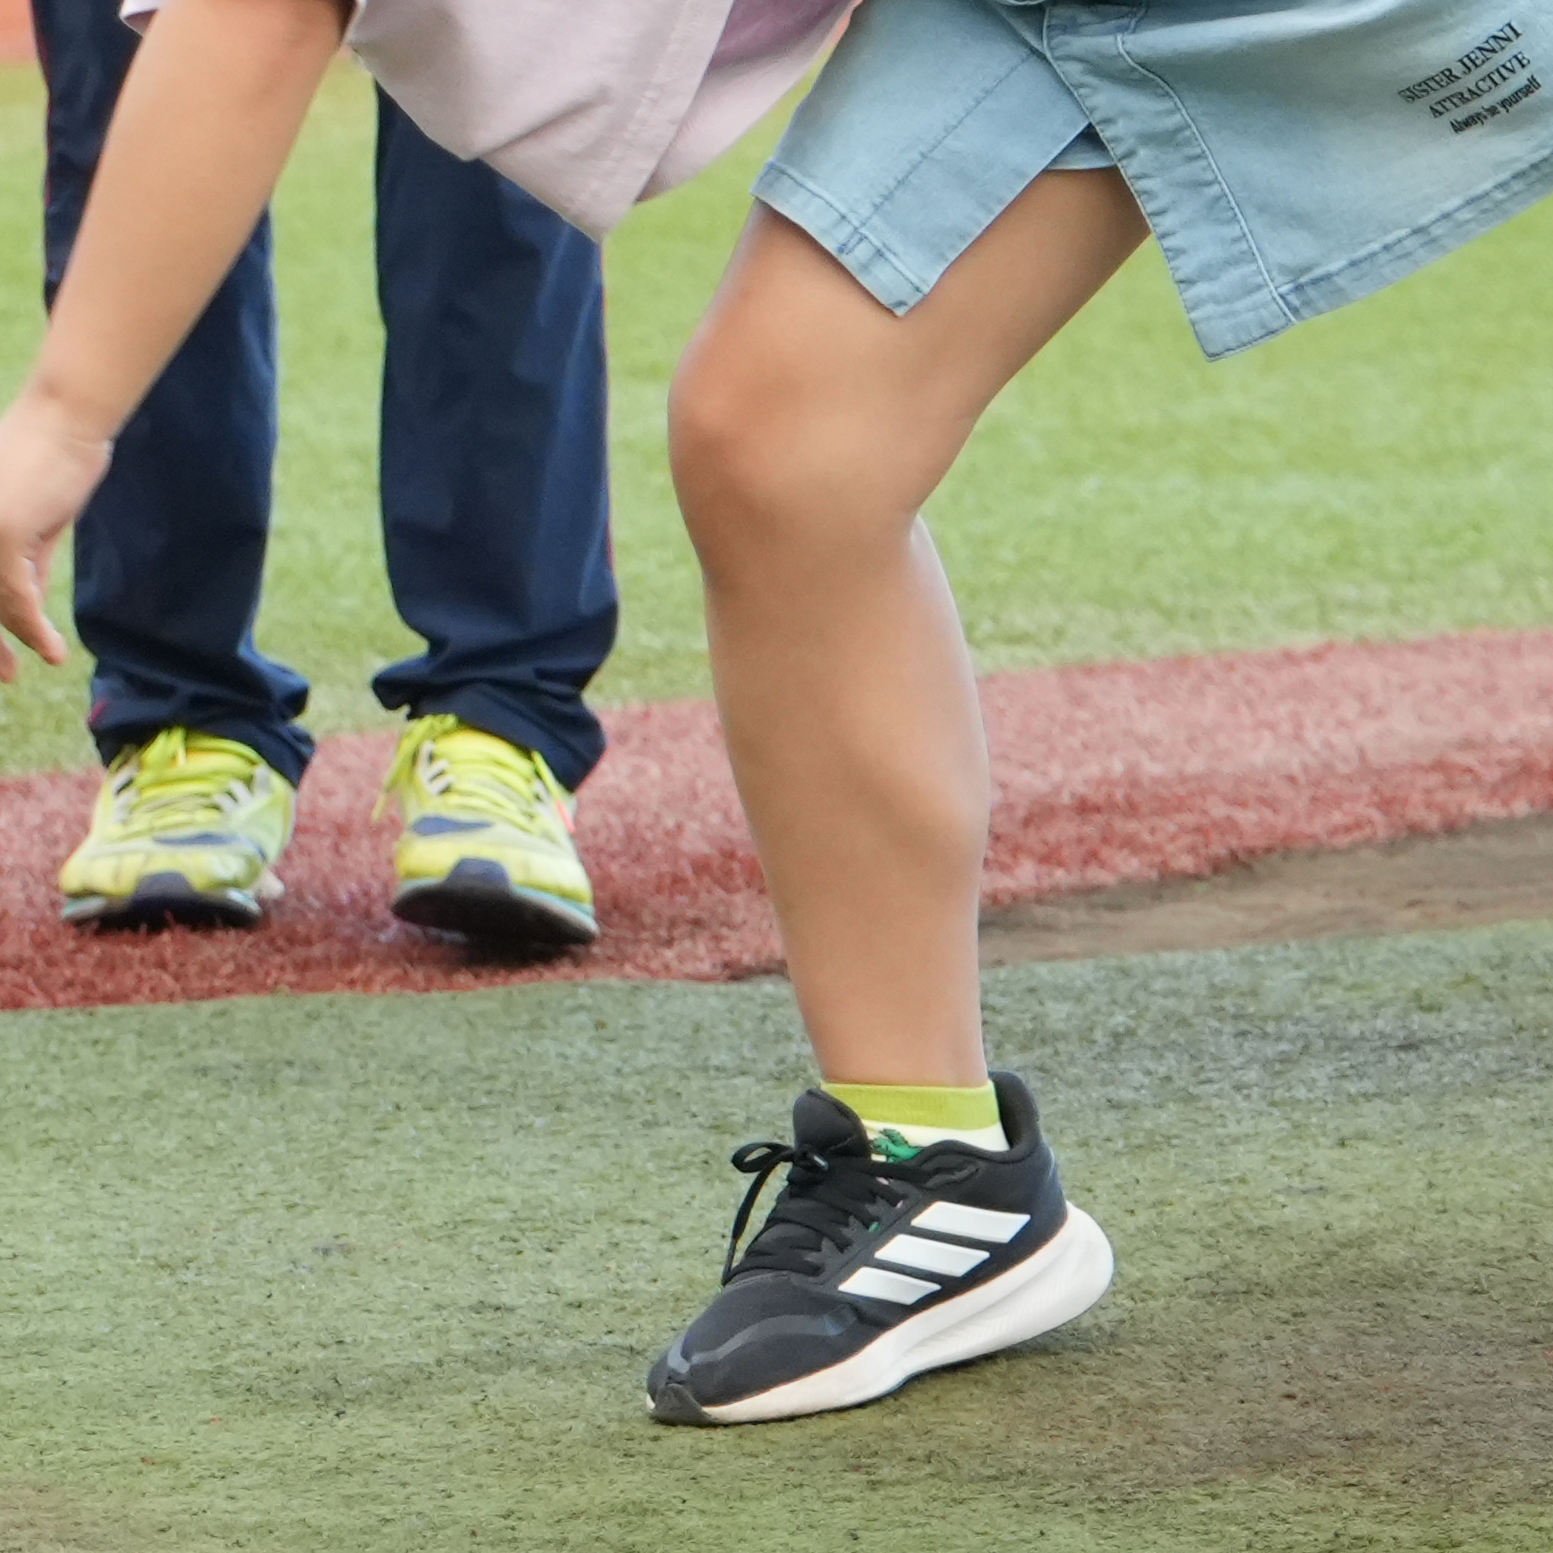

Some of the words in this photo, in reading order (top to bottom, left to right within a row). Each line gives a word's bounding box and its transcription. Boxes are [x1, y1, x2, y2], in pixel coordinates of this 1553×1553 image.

[1398, 67, 1462, 104] SISTER
[1456, 21, 1522, 75] JENNI
[1429, 51, 1531, 118] ATTRACTIVE
[1449, 111, 1488, 134] Always
[1481, 105, 1501, 118] be
[1497, 74, 1541, 113] yourself
